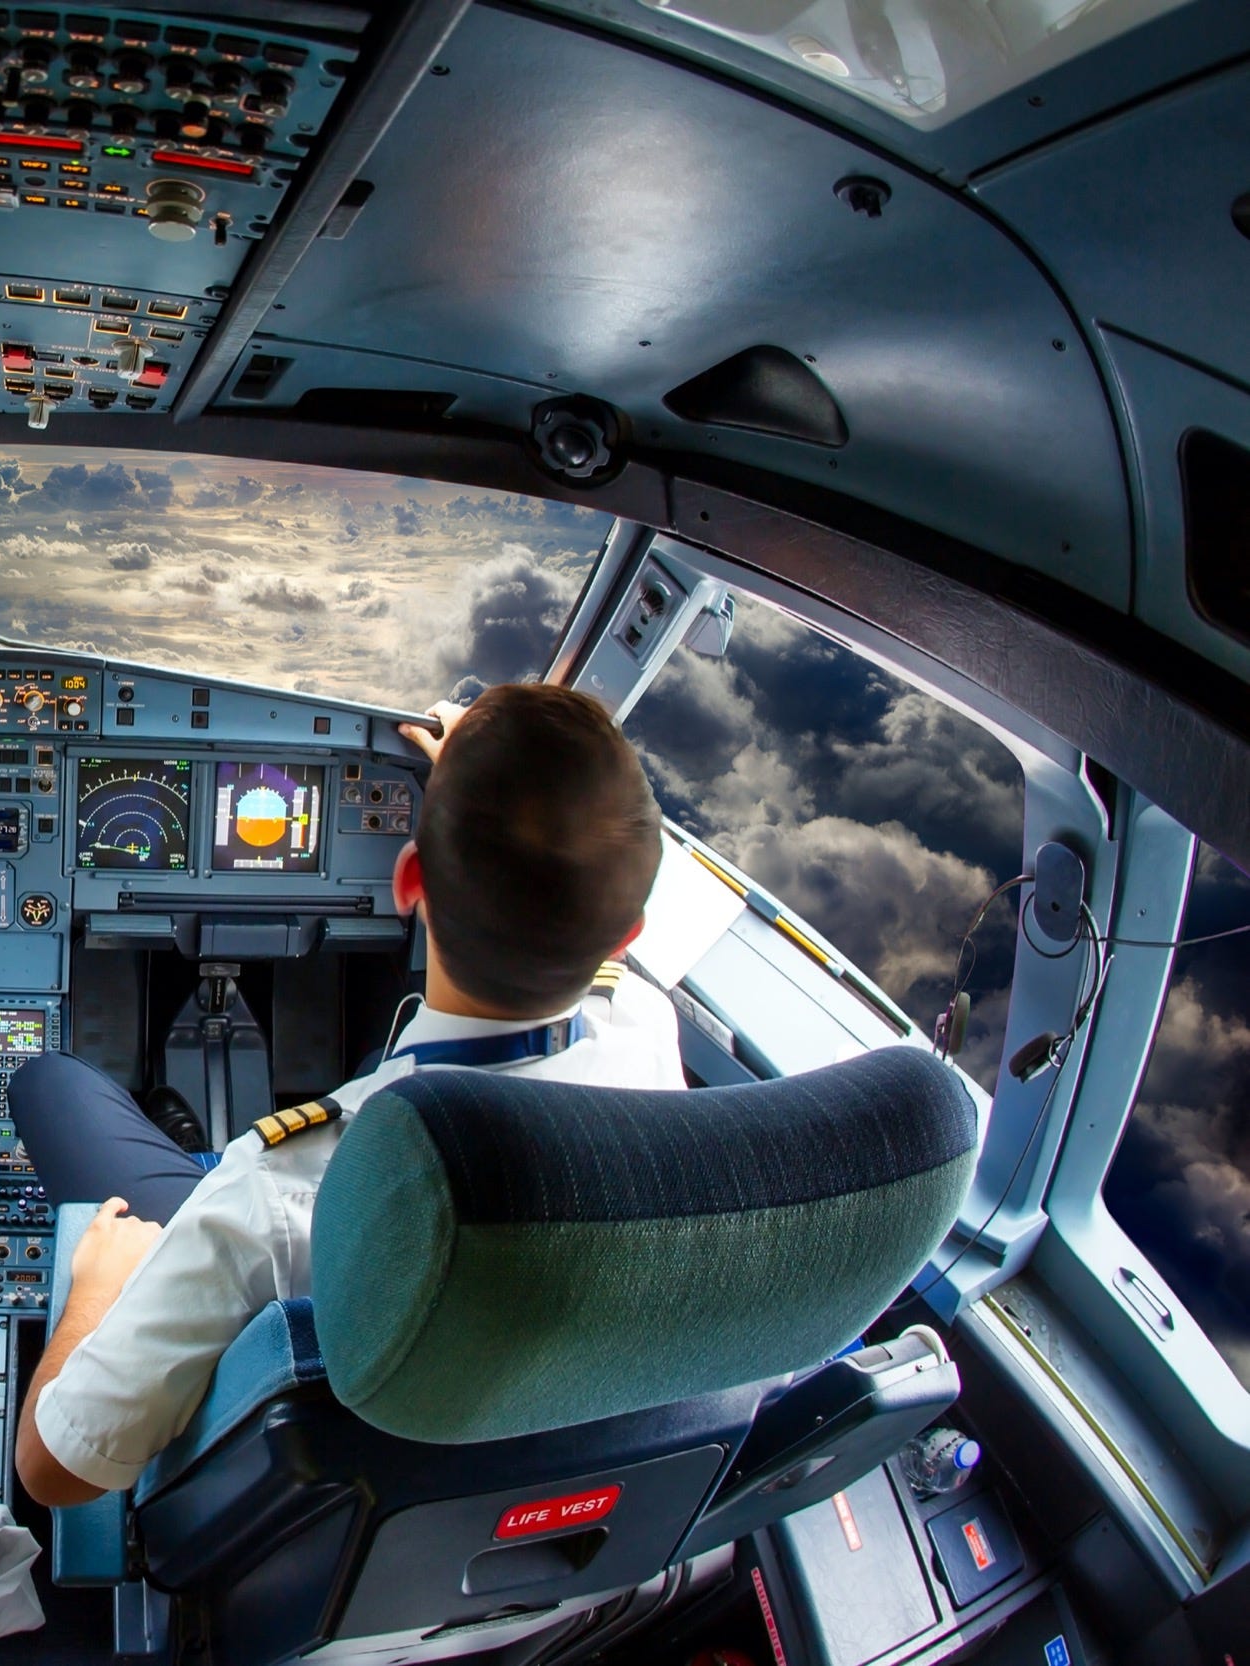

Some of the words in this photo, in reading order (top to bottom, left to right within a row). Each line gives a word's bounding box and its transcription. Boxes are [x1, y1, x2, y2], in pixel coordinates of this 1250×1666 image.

[21, 160, 48, 169] VHF2
[62, 165, 88, 174] VHF3
[64, 680, 85, 689] 1004
[507, 1508, 551, 1527] LIFE
[560, 1496, 609, 1517] VEST
